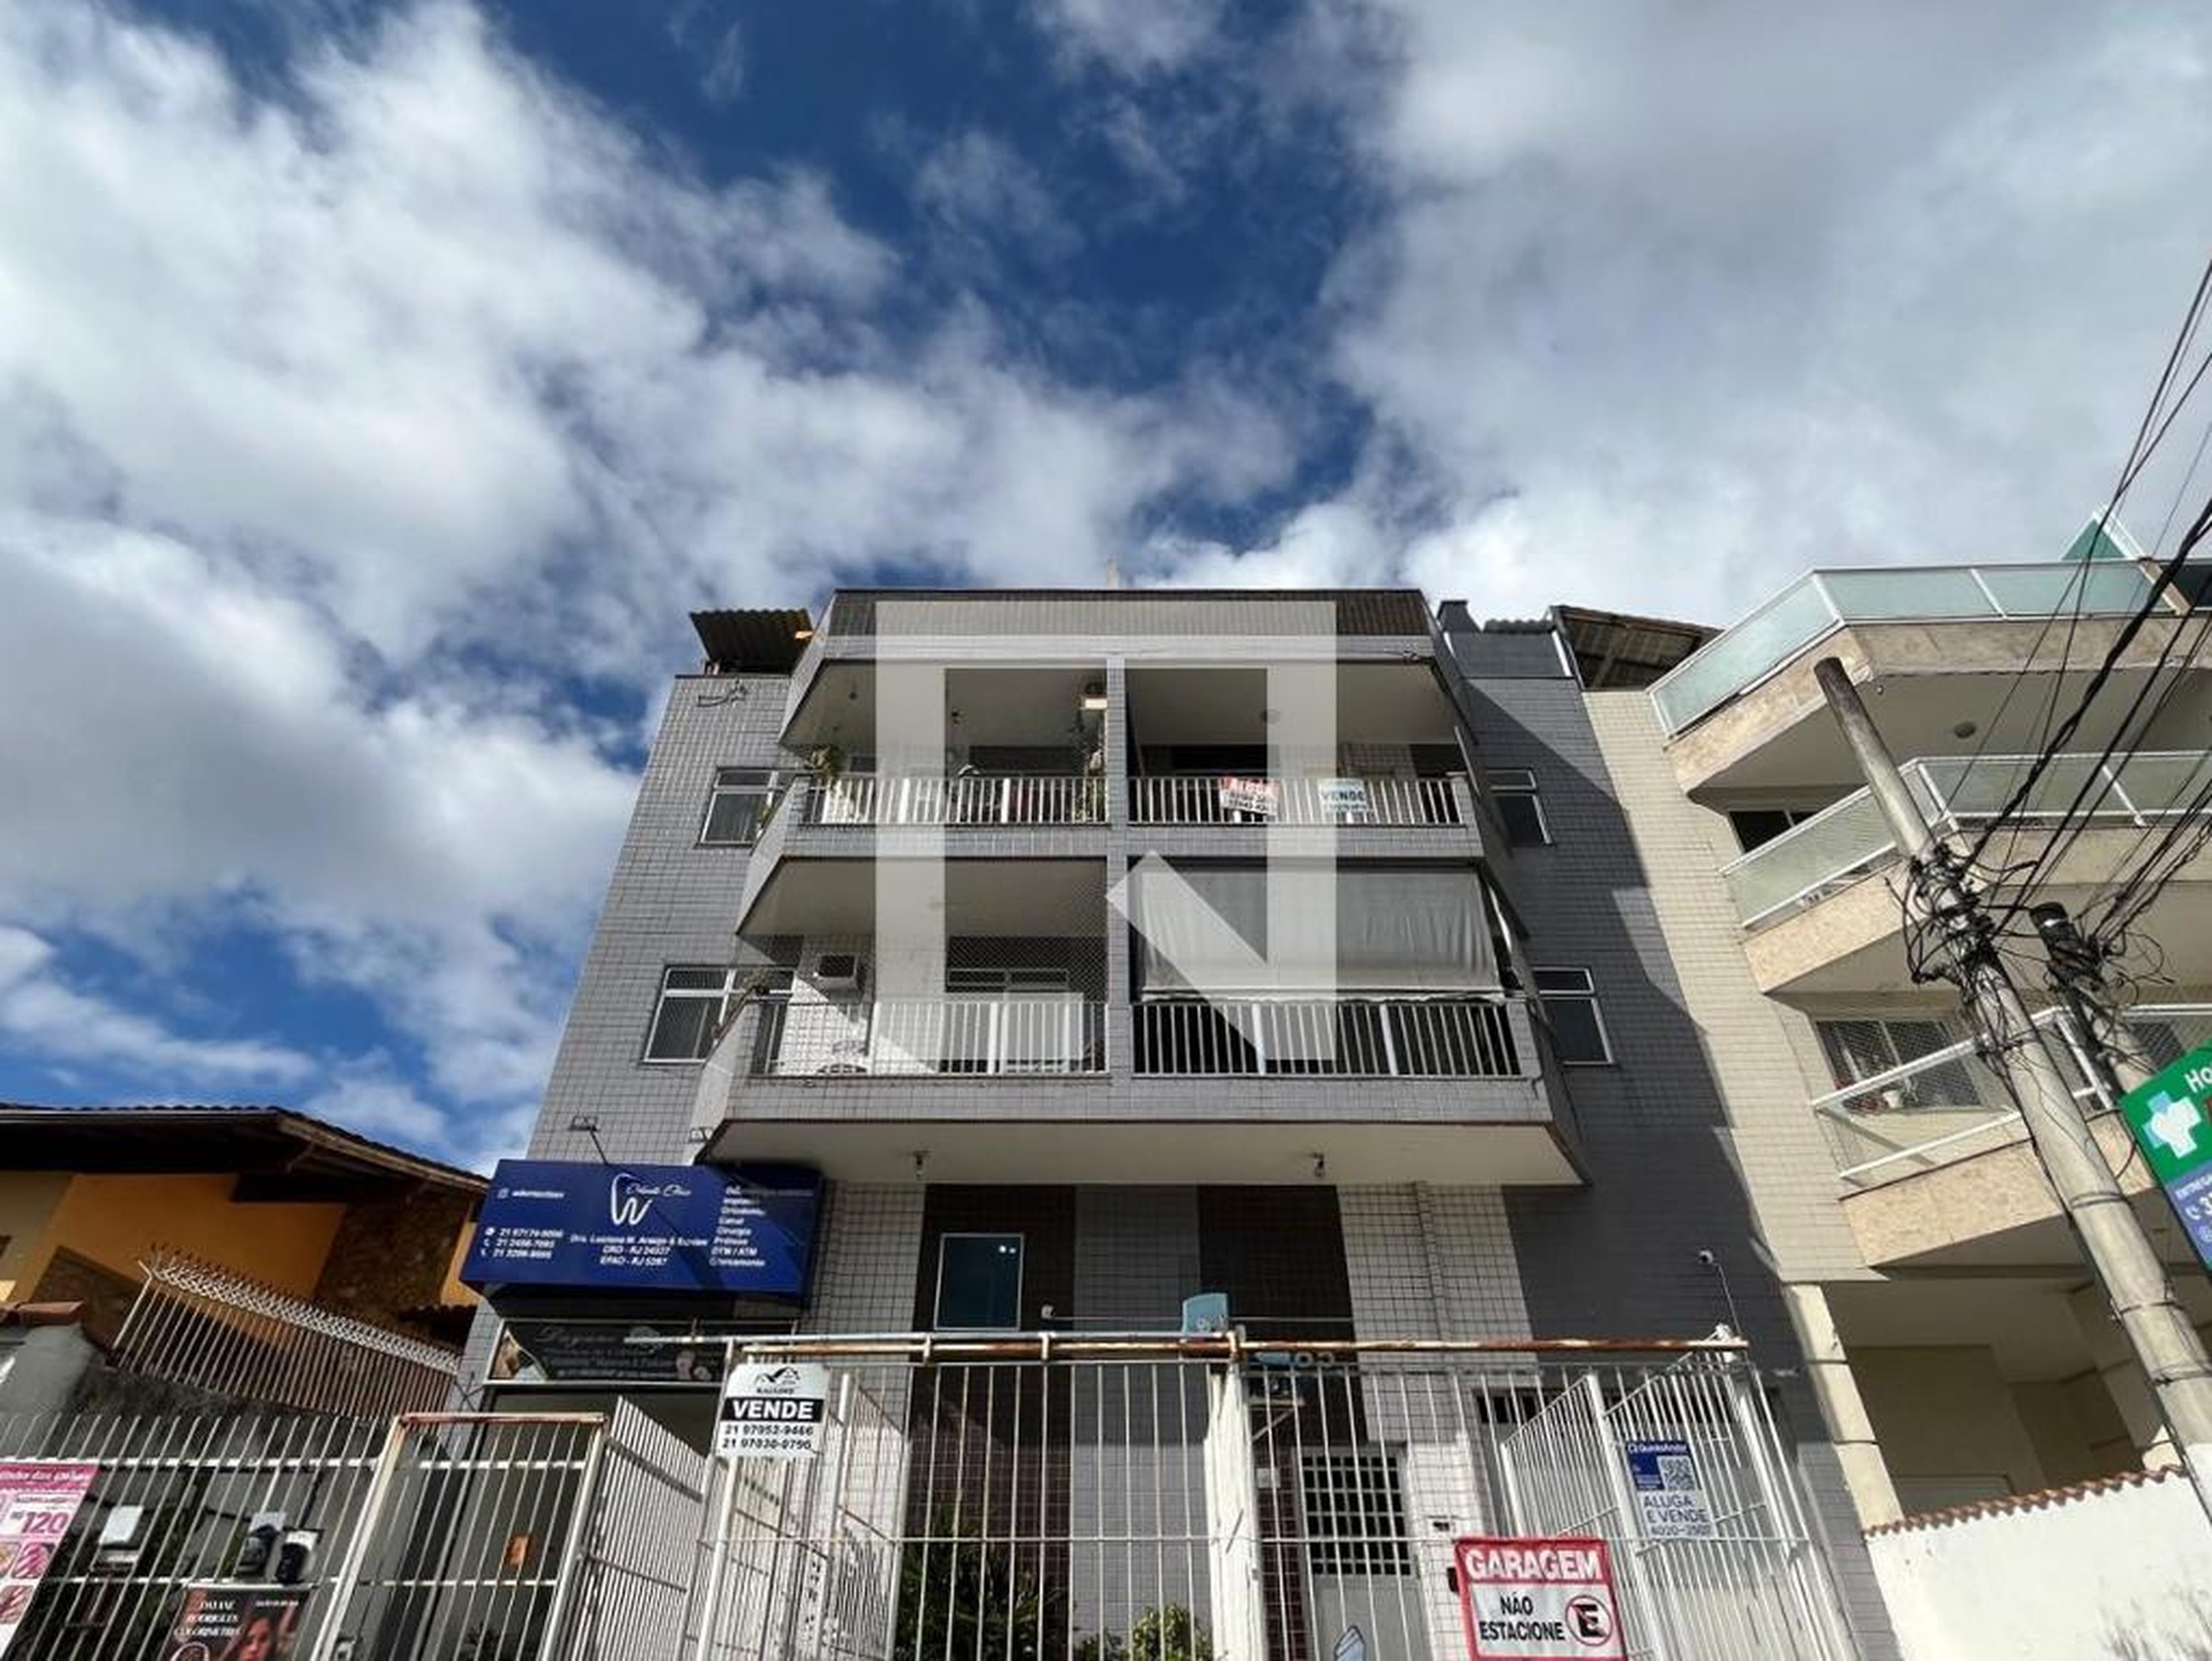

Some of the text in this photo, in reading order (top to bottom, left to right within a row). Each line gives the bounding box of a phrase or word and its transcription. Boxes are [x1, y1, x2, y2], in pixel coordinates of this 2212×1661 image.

[732, 1398, 815, 1420] VENDE
[725, 1424, 738, 1435] 21
[722, 1437, 737, 1448] 21
[1643, 1494, 1695, 1508] ALUGA
[22, 1511, 70, 1534] 120
[1658, 1509, 1710, 1523] VENDE
[1464, 1550, 1601, 1580] GARAGEM
[1499, 1592, 1534, 1615] NÃO
[1479, 1622, 1566, 1642] ESTACIONE
